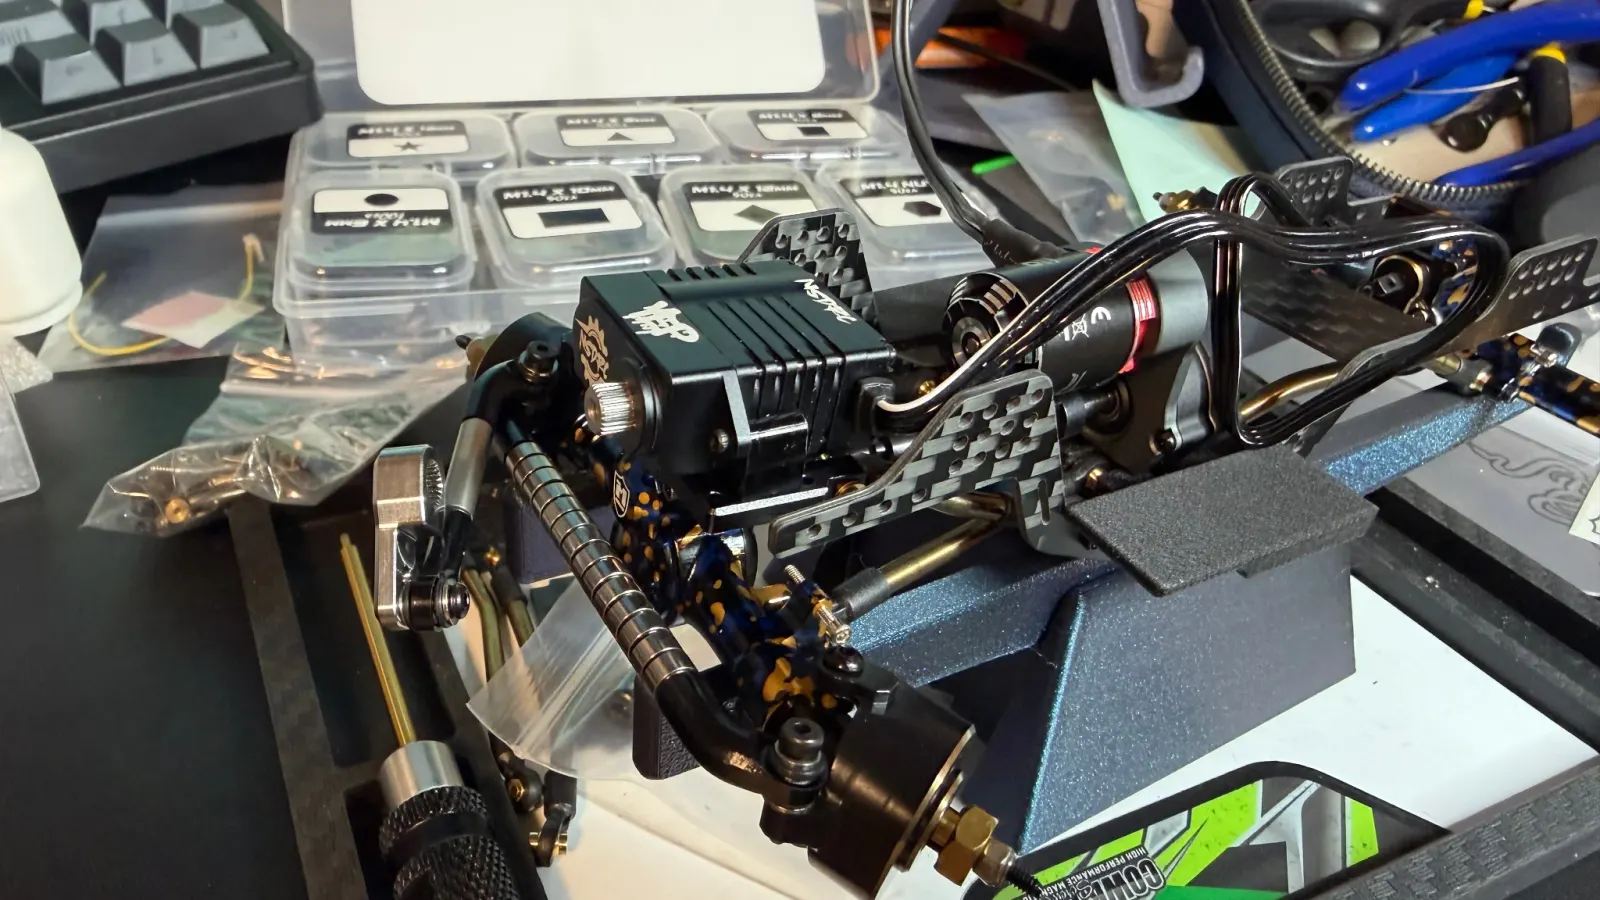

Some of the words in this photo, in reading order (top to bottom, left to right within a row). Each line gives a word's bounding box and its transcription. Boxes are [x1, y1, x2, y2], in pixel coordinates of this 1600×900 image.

[900, 179, 929, 189] NU
[1124, 846, 1147, 861] HIGH
[1066, 857, 1126, 887] PERFORMANCE
